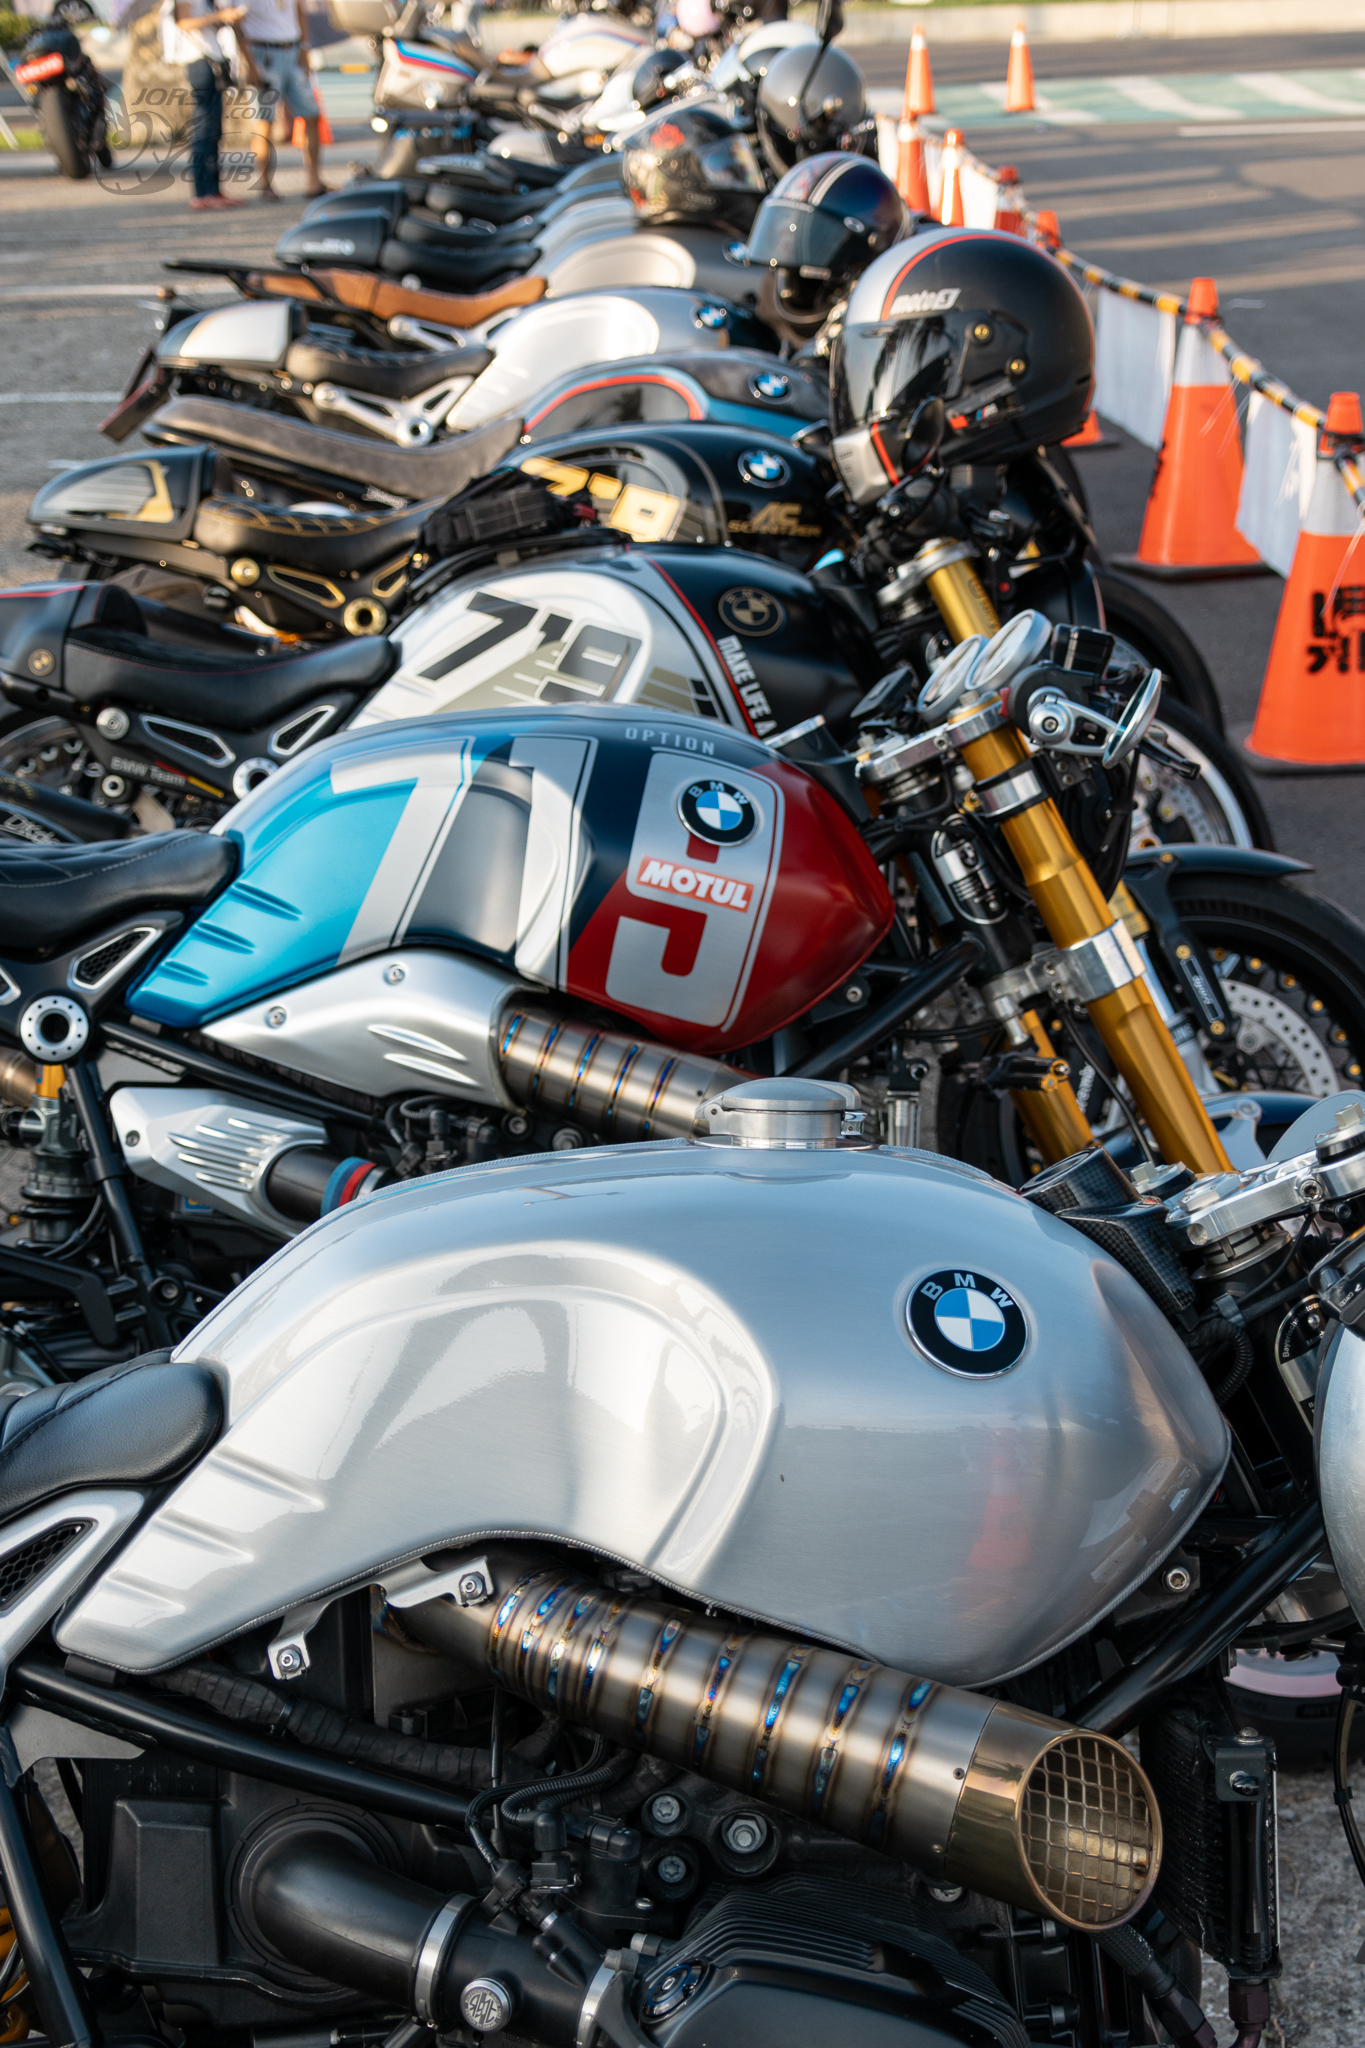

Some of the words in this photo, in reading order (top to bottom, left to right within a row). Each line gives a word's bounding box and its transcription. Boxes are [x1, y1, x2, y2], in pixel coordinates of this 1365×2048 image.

[717, 634, 756, 685] MAKE
[739, 681, 772, 720] LIFE
[624, 726, 715, 756] OPTION
[109, 755, 149, 778] BMW
[149, 764, 187, 788] Team
[687, 780, 749, 805] BMW
[638, 858, 749, 910] MOTUL
[1075, 1061, 1097, 1114] remb
[920, 1272, 1014, 1308] BMW
